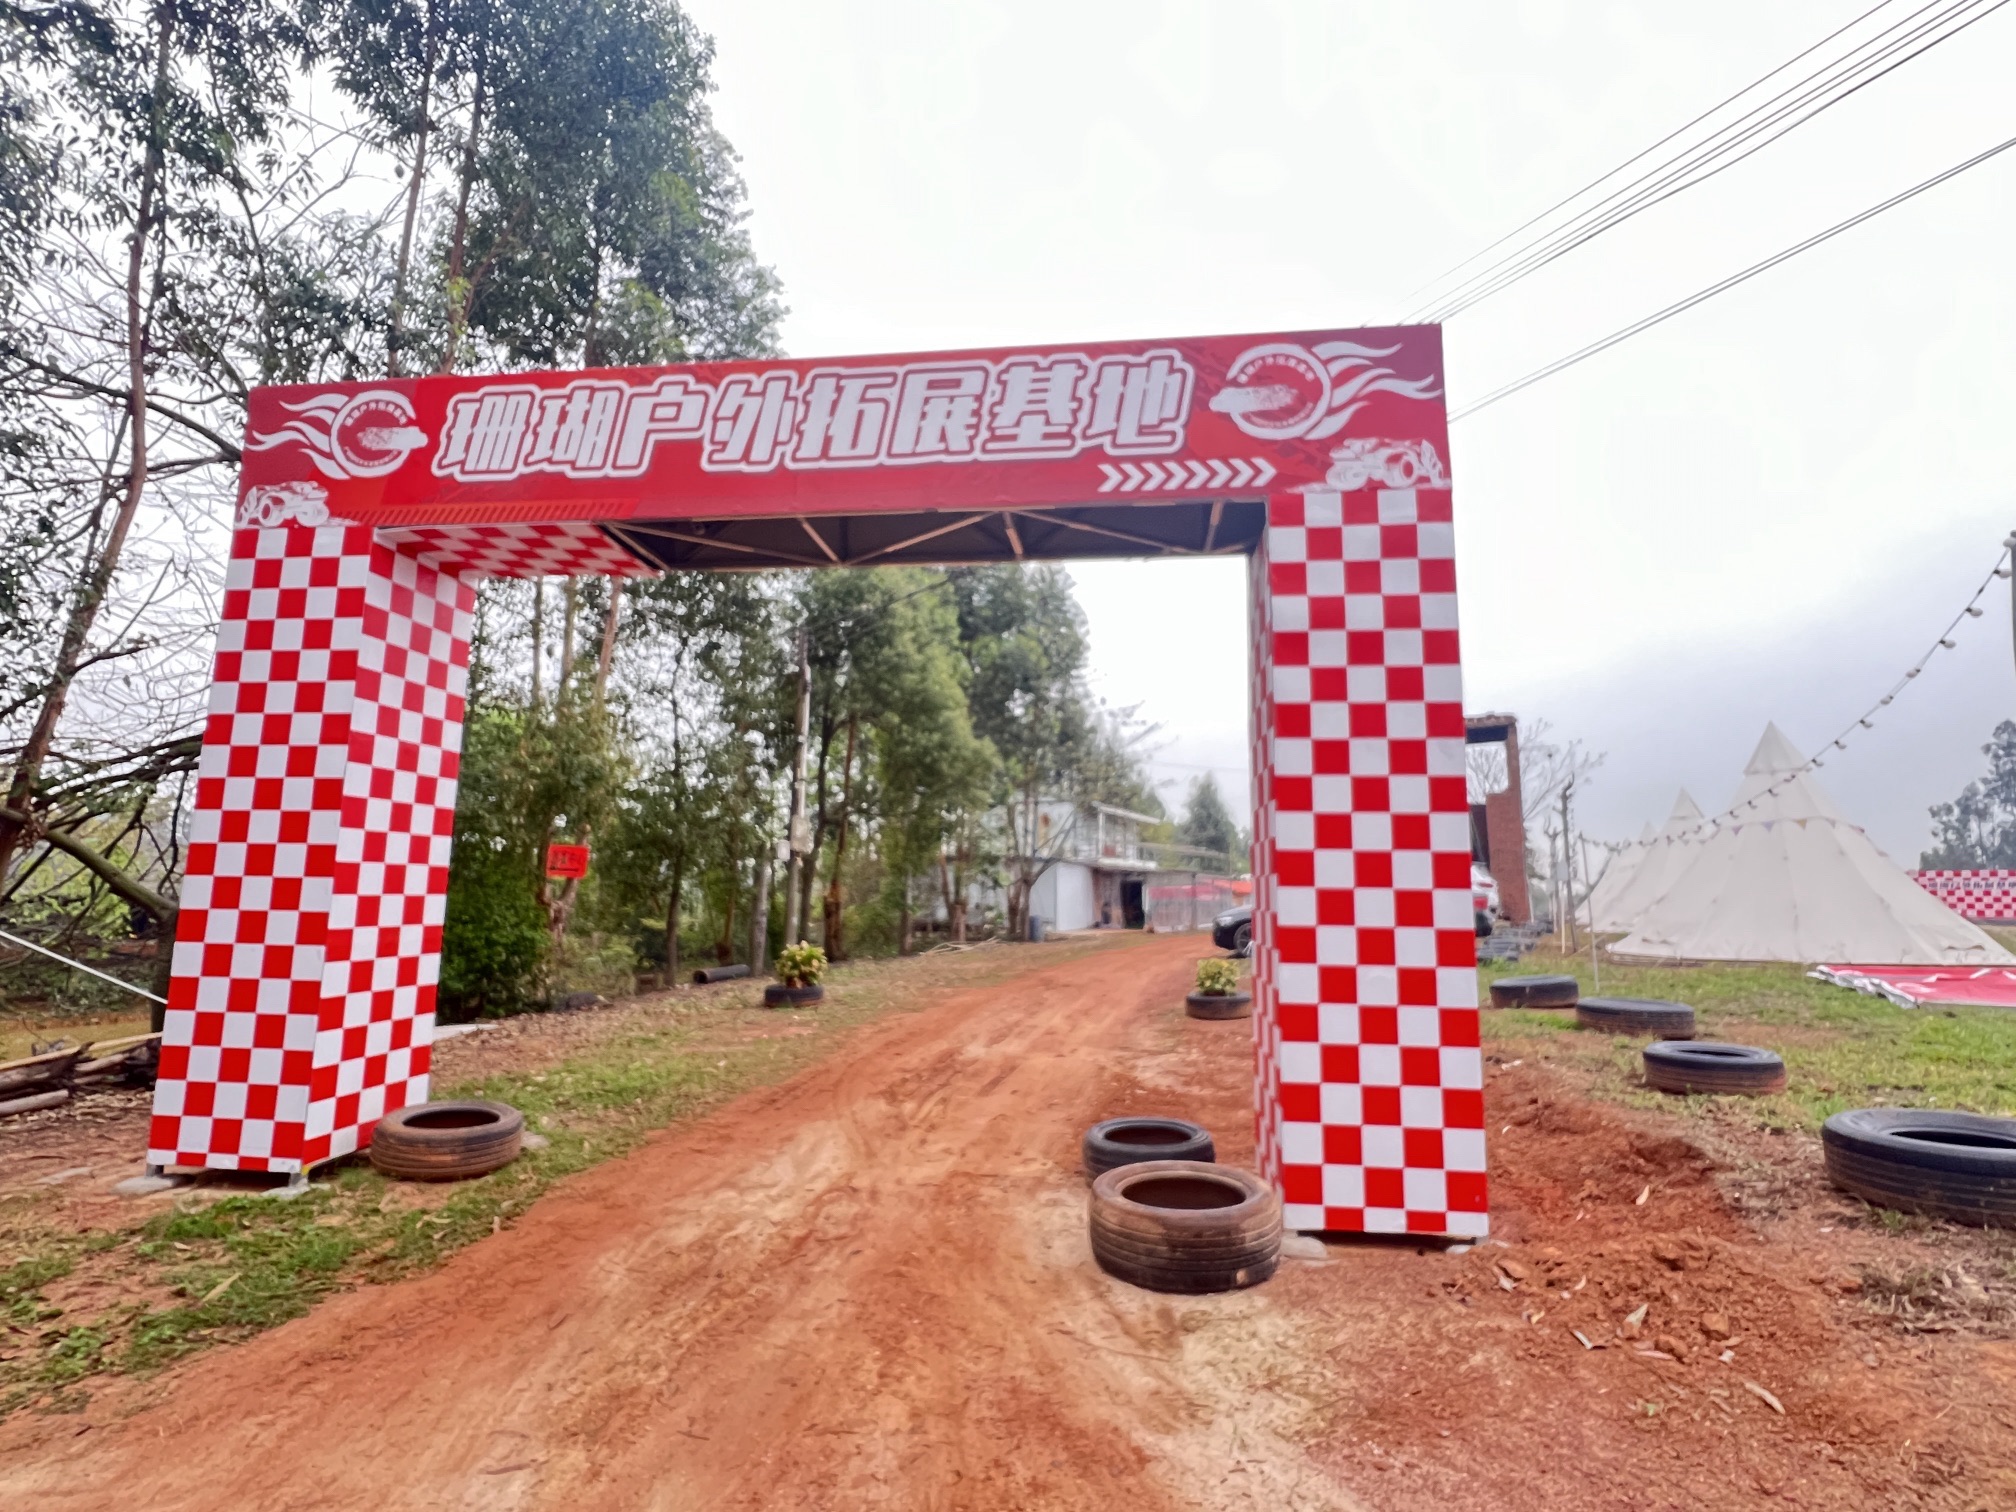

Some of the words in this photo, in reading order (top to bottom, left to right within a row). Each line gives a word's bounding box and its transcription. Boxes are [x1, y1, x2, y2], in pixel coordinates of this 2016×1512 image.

[432, 349, 1194, 482] 珊瑚户外拓展基地
